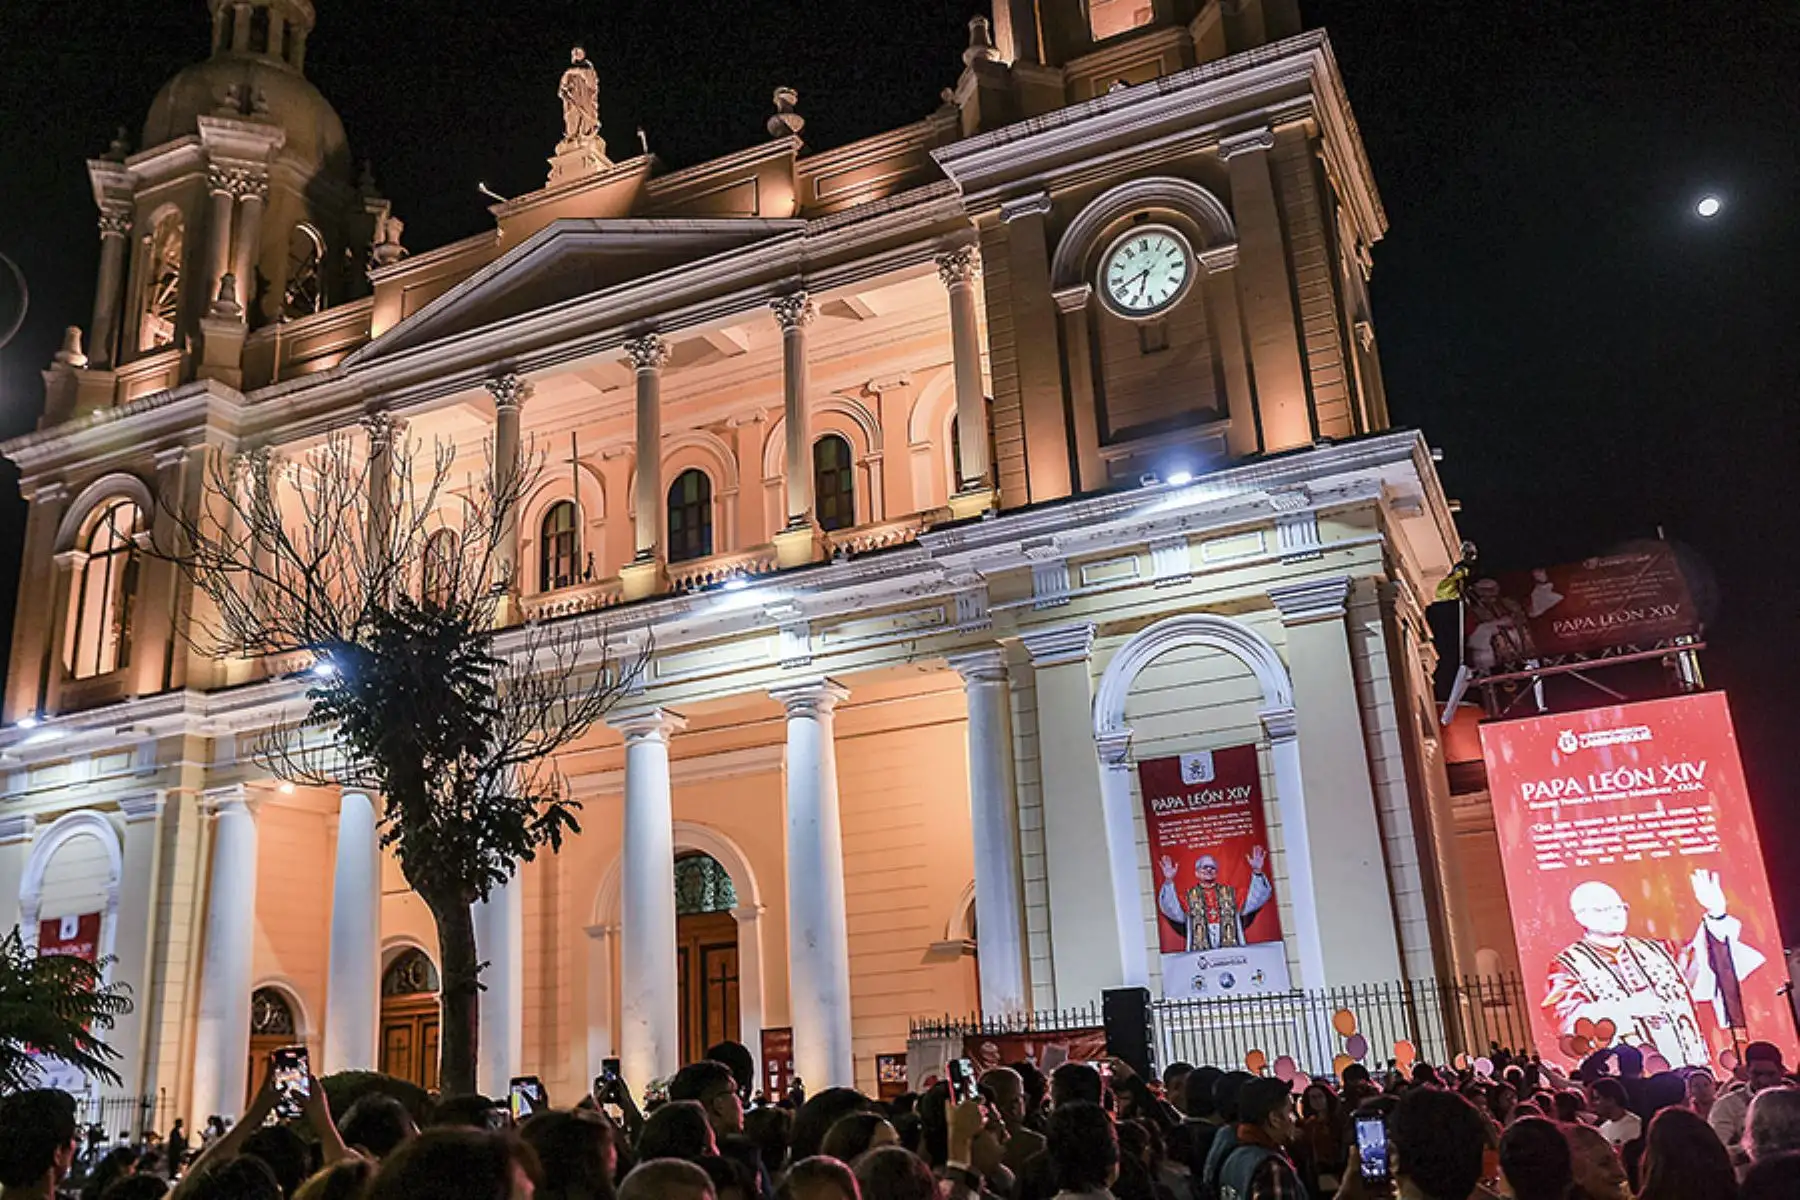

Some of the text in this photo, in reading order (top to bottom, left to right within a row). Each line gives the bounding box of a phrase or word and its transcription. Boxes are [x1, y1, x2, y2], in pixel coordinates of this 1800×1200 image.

[1553, 617, 1596, 633] PAPA
[1650, 603, 1680, 617] XIV
[1521, 777, 1584, 800] PAPA
[1588, 765, 1656, 792] LEÓN
[1660, 761, 1707, 783] XIV
[1151, 796, 1184, 811] PAPA
[1187, 789, 1224, 806] LEÓN
[1226, 785, 1251, 800] XIV
